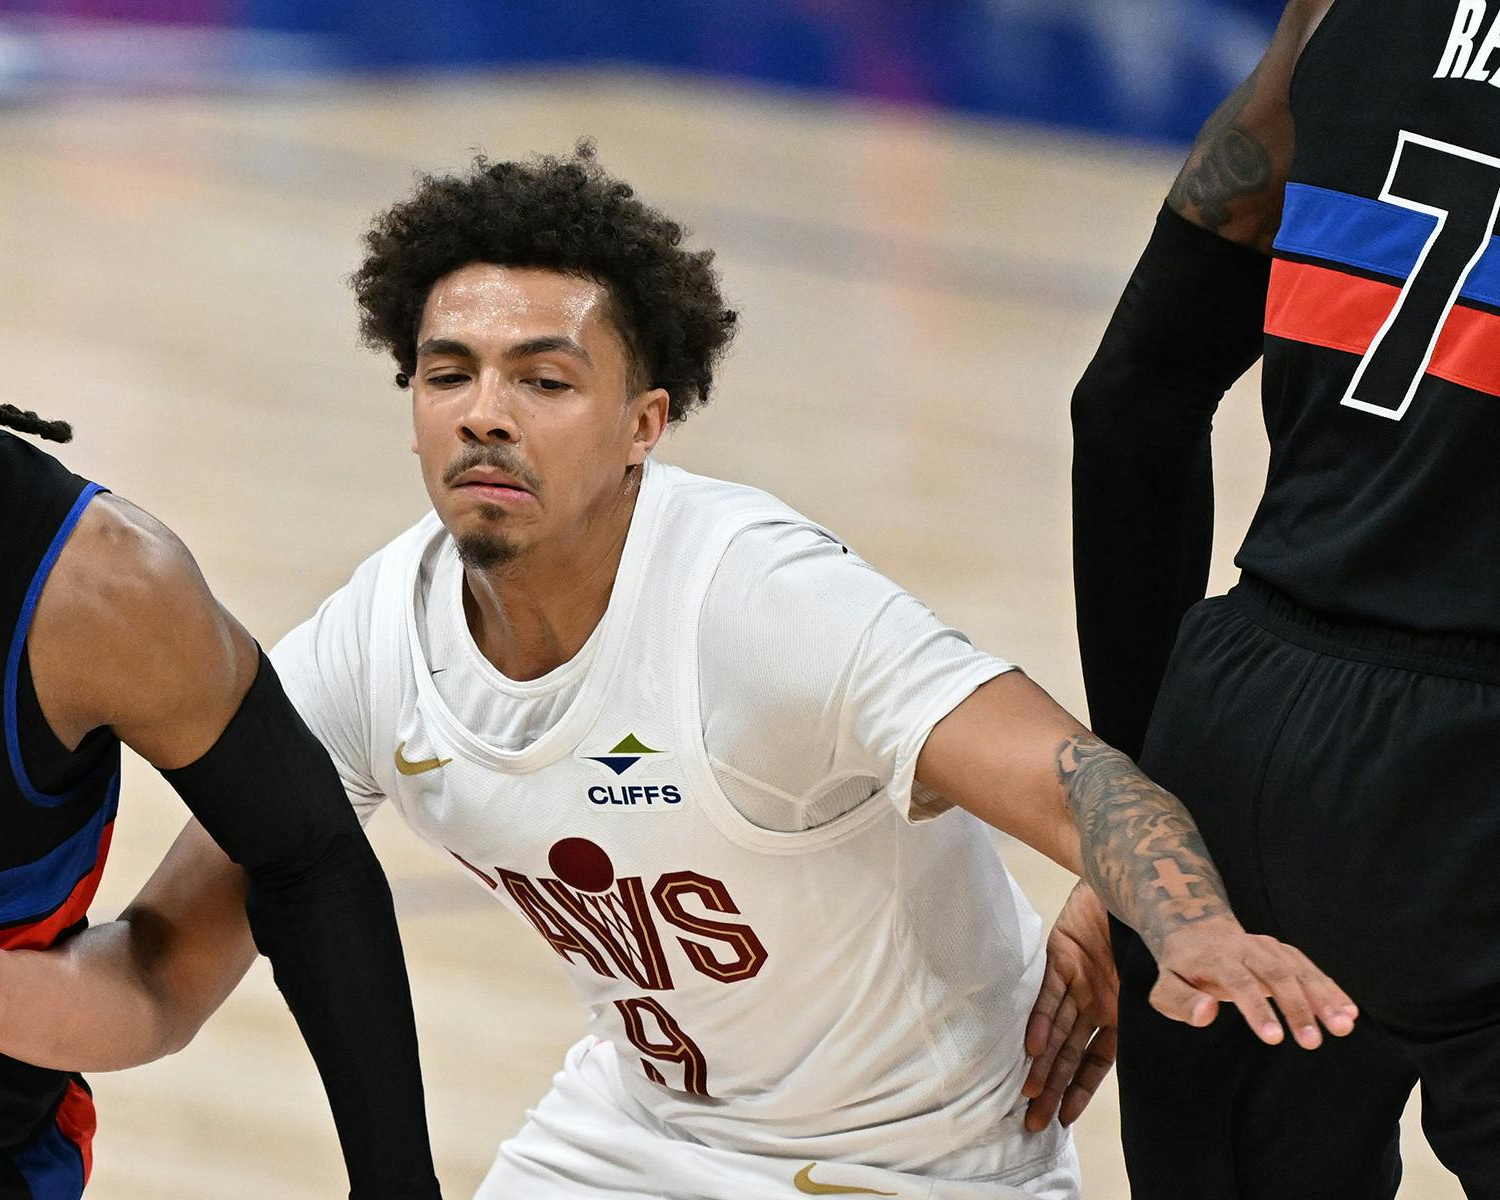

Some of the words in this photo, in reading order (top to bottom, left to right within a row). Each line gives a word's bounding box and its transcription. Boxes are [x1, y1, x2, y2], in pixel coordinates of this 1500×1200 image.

[1432, 0, 1500, 88] RE
[1340, 130, 1500, 421] 7
[587, 784, 682, 806] CLIFFS
[444, 838, 769, 991] AVS
[613, 996, 712, 1100] 9
